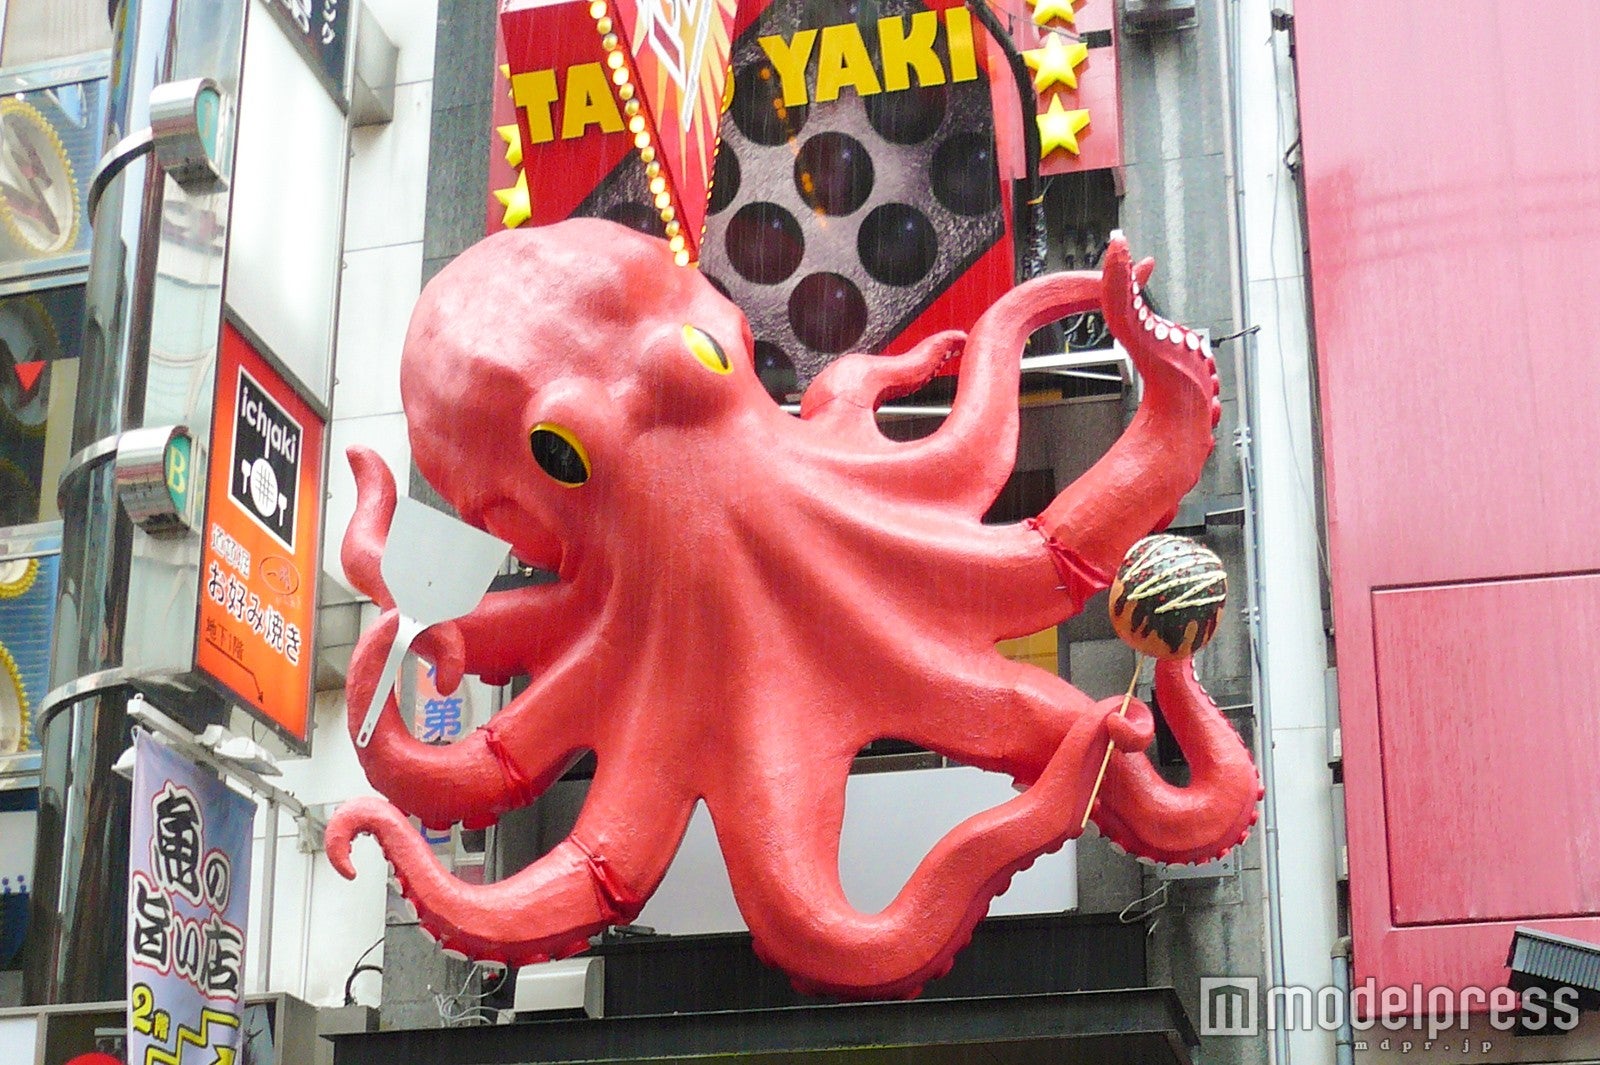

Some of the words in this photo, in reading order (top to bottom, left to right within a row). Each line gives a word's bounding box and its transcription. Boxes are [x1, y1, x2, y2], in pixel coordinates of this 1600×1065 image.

[757, 6, 977, 107] YAKI
[168, 446, 186, 494] B
[209, 561, 301, 667] お好み焼き
